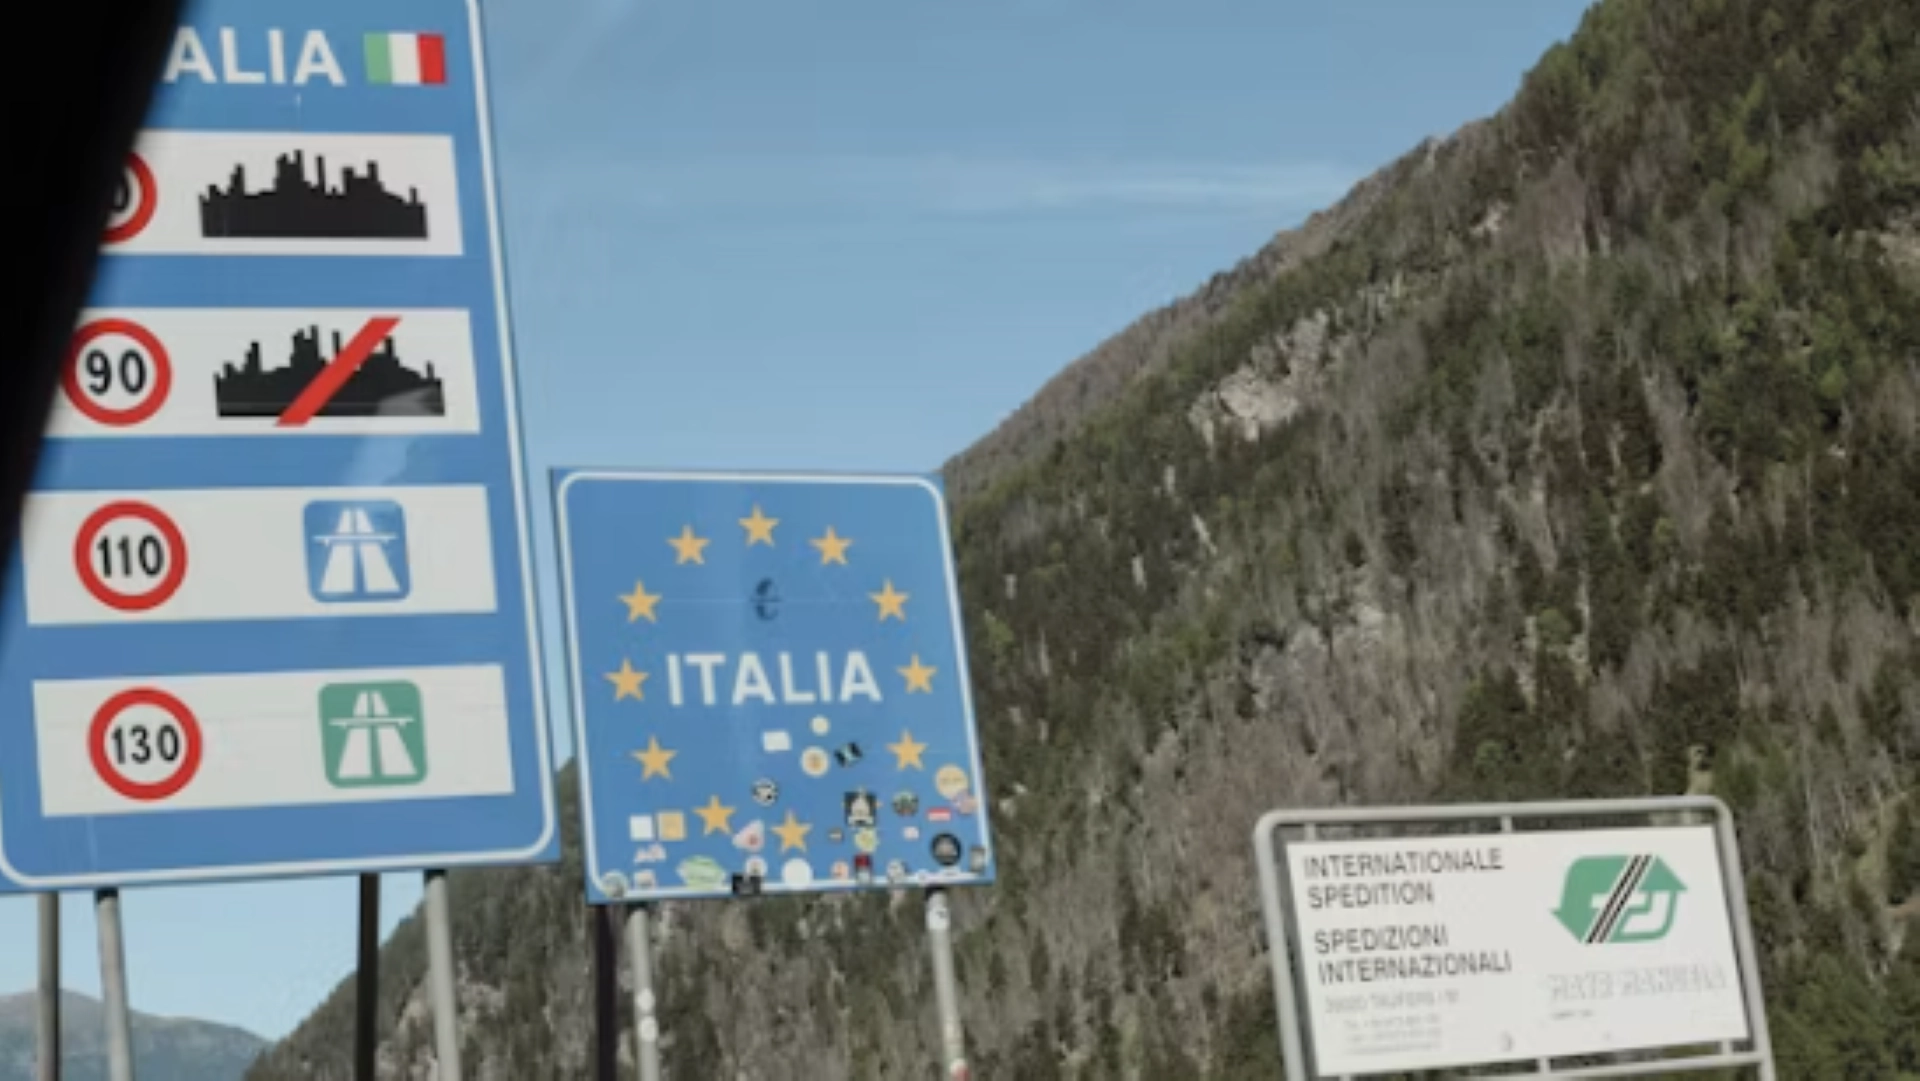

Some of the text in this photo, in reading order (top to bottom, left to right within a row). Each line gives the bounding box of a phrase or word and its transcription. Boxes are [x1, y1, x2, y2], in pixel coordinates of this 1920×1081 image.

[163, 27, 346, 85] ALIA
[85, 349, 147, 395] 90
[96, 535, 165, 578] 110
[666, 651, 882, 706] ITALIA
[111, 723, 181, 765] 130
[1304, 848, 1504, 878] INTERNATIONALE
[1306, 880, 1435, 909] SPEDITION
[1314, 923, 1449, 954] SPEDIZIONI
[1318, 950, 1512, 985] INTERNAZIONALI
